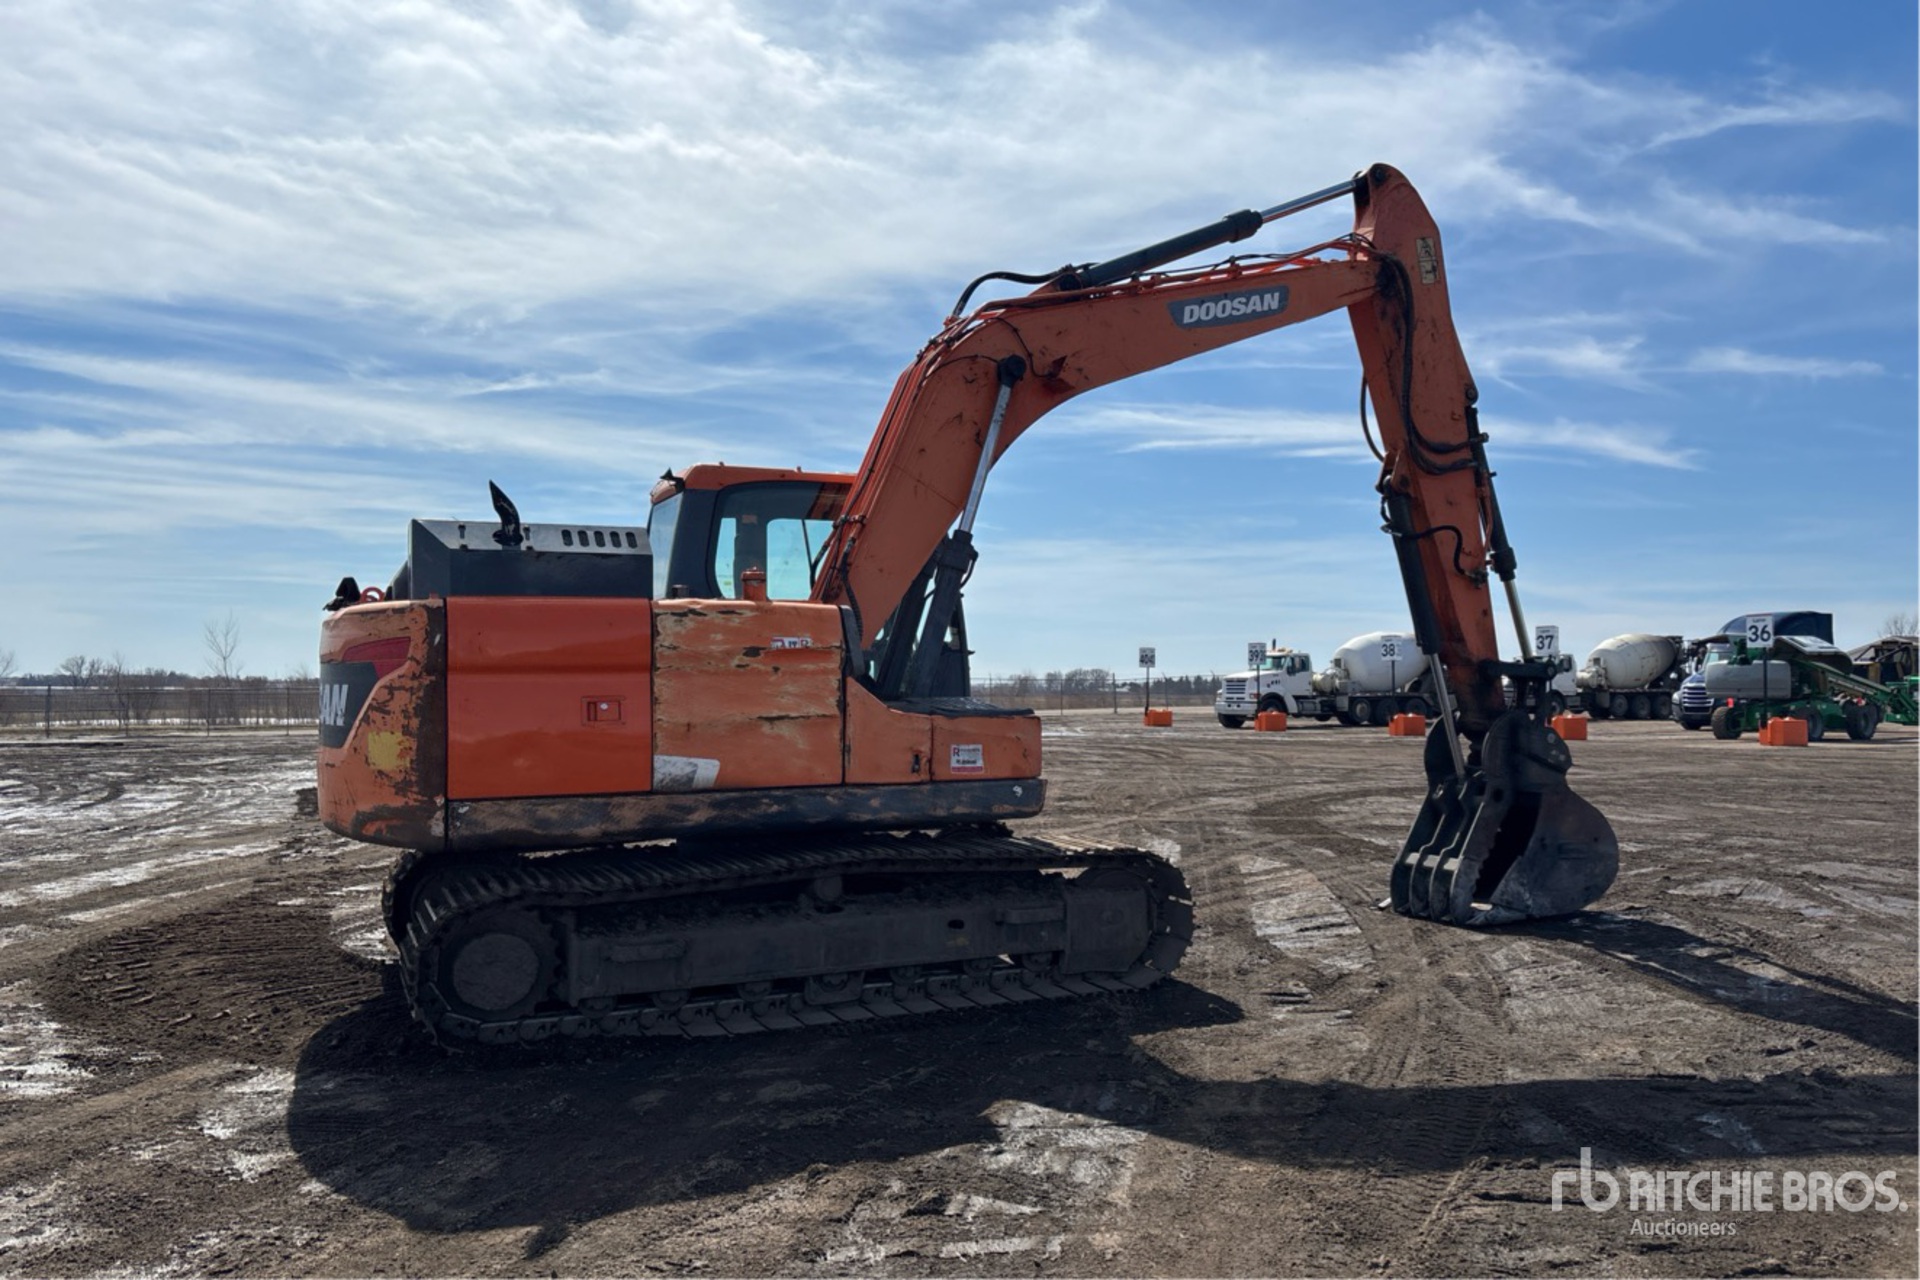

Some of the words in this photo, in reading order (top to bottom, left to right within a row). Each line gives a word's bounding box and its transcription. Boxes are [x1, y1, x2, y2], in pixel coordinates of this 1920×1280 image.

[1183, 292, 1280, 324] DOOSAN
[1536, 635, 1554, 650] 37
[1748, 624, 1771, 643] 36
[1381, 643, 1396, 657] 38
[319, 683, 349, 727] AN
